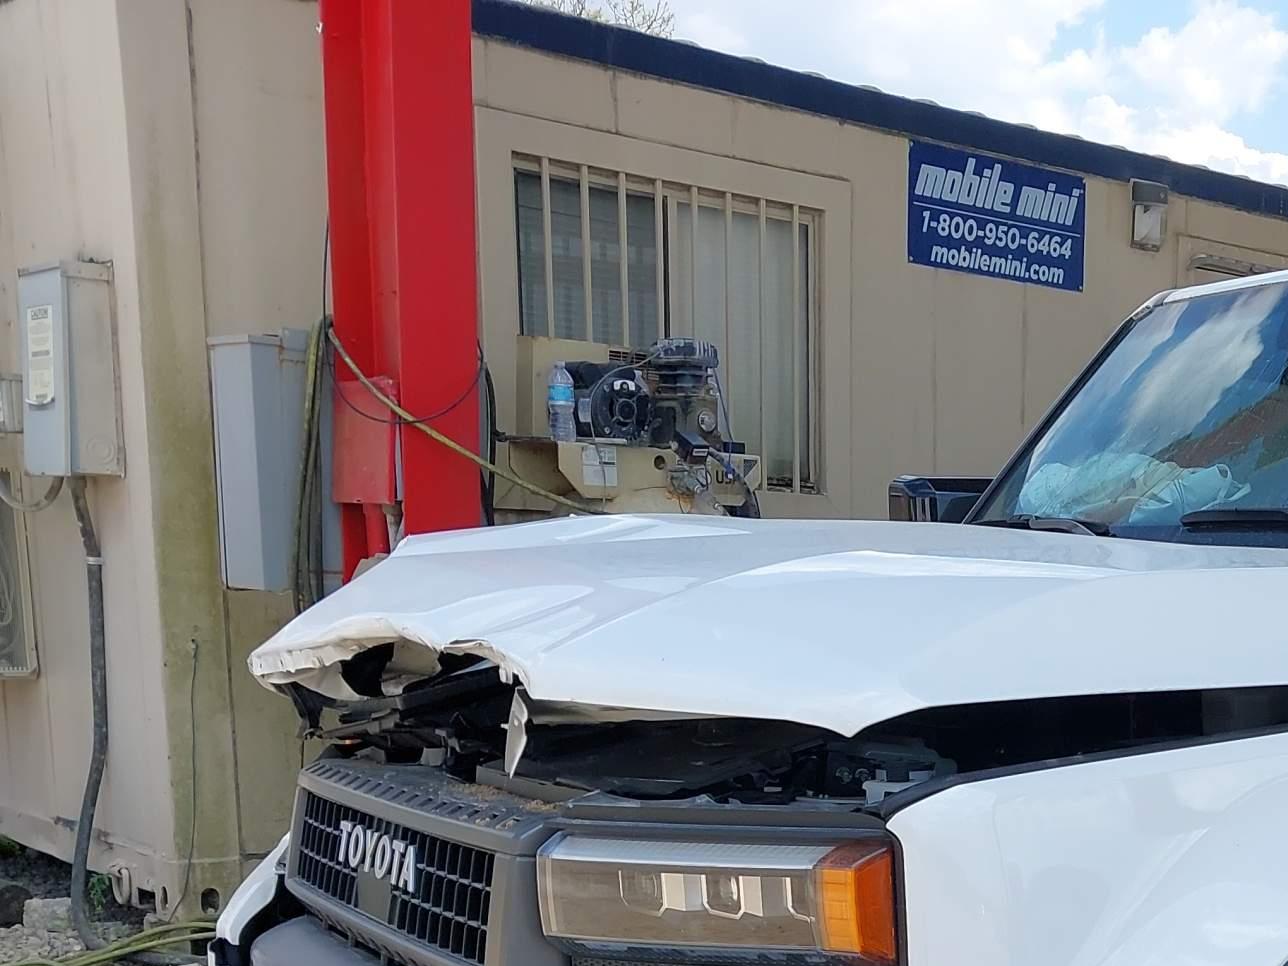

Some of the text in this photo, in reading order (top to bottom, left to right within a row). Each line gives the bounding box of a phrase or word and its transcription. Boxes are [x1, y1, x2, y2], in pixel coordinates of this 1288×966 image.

[914, 157, 1081, 226] mobile mini
[921, 210, 1073, 259] 1-800-950-6464
[930, 245, 1065, 284] mobilemini.com
[338, 819, 417, 893] TOYOTA
